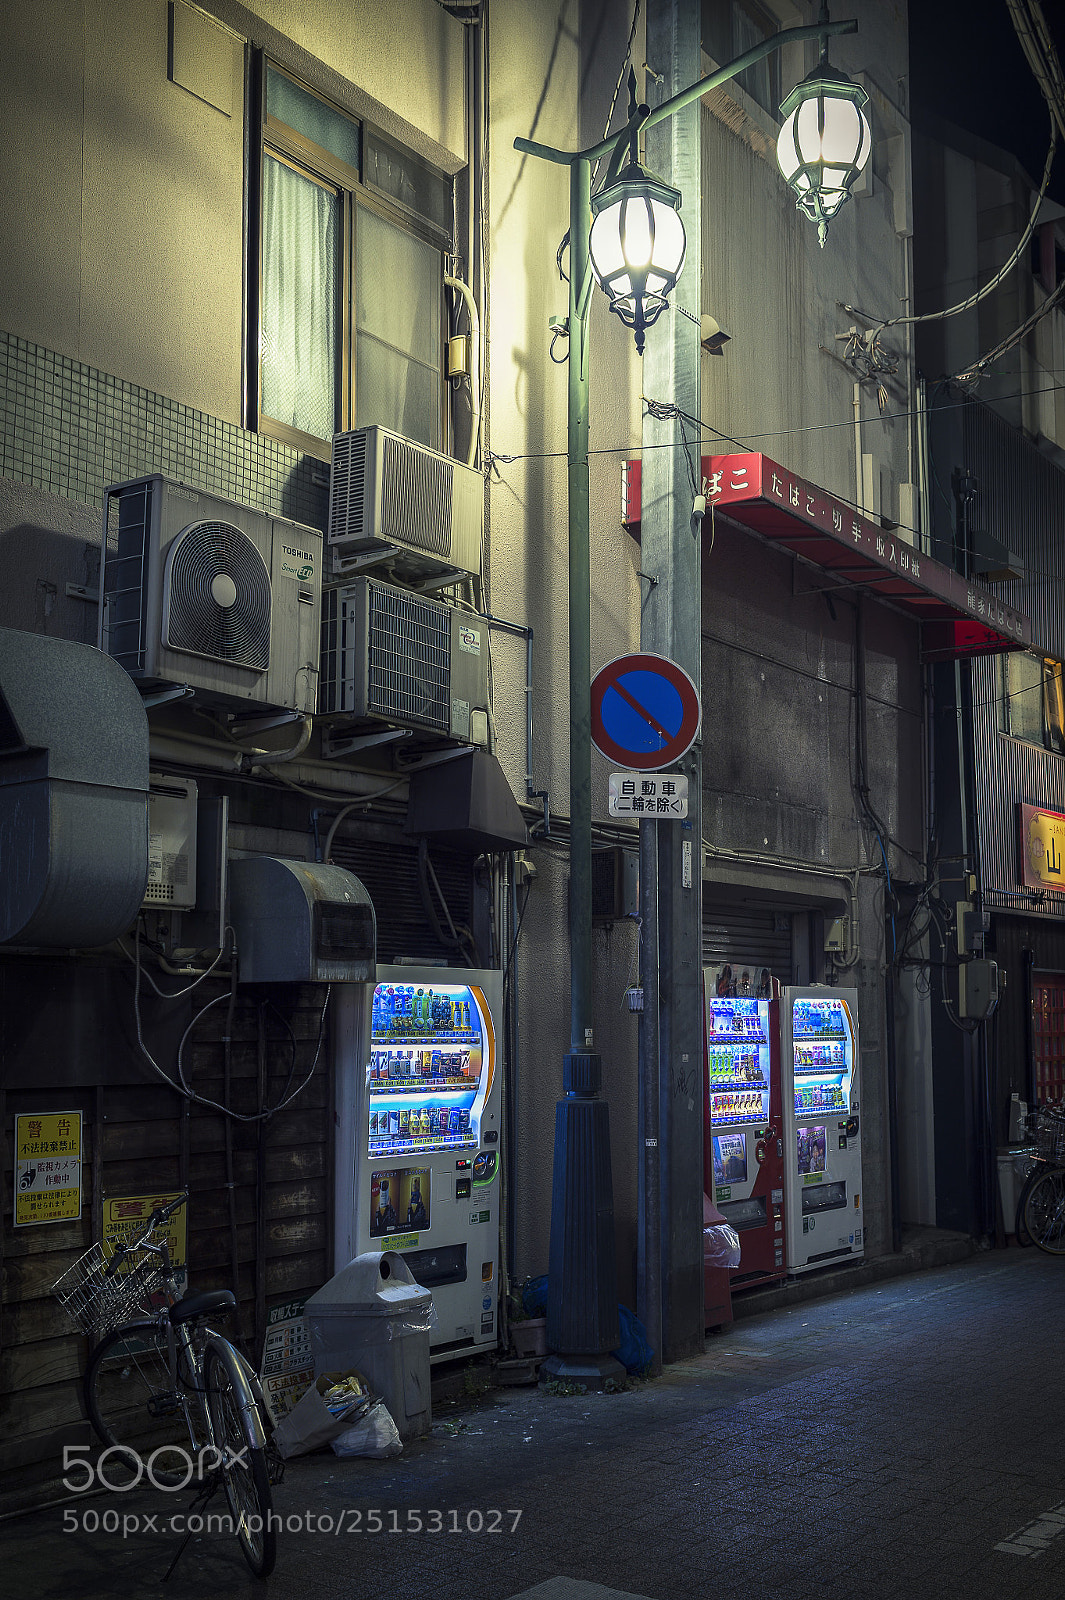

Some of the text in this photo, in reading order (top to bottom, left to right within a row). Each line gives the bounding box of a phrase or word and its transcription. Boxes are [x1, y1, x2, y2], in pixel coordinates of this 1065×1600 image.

[282, 545, 314, 562] TOSHIBA
[622, 780, 676, 796] 自動車
[1047, 837, 1061, 875] 山
[28, 1119, 70, 1138] 警告
[20, 1140, 77, 1154] 不法投棄禁止
[37, 1160, 78, 1172] 監視カメラ
[45, 1174, 70, 1185] 作動中
